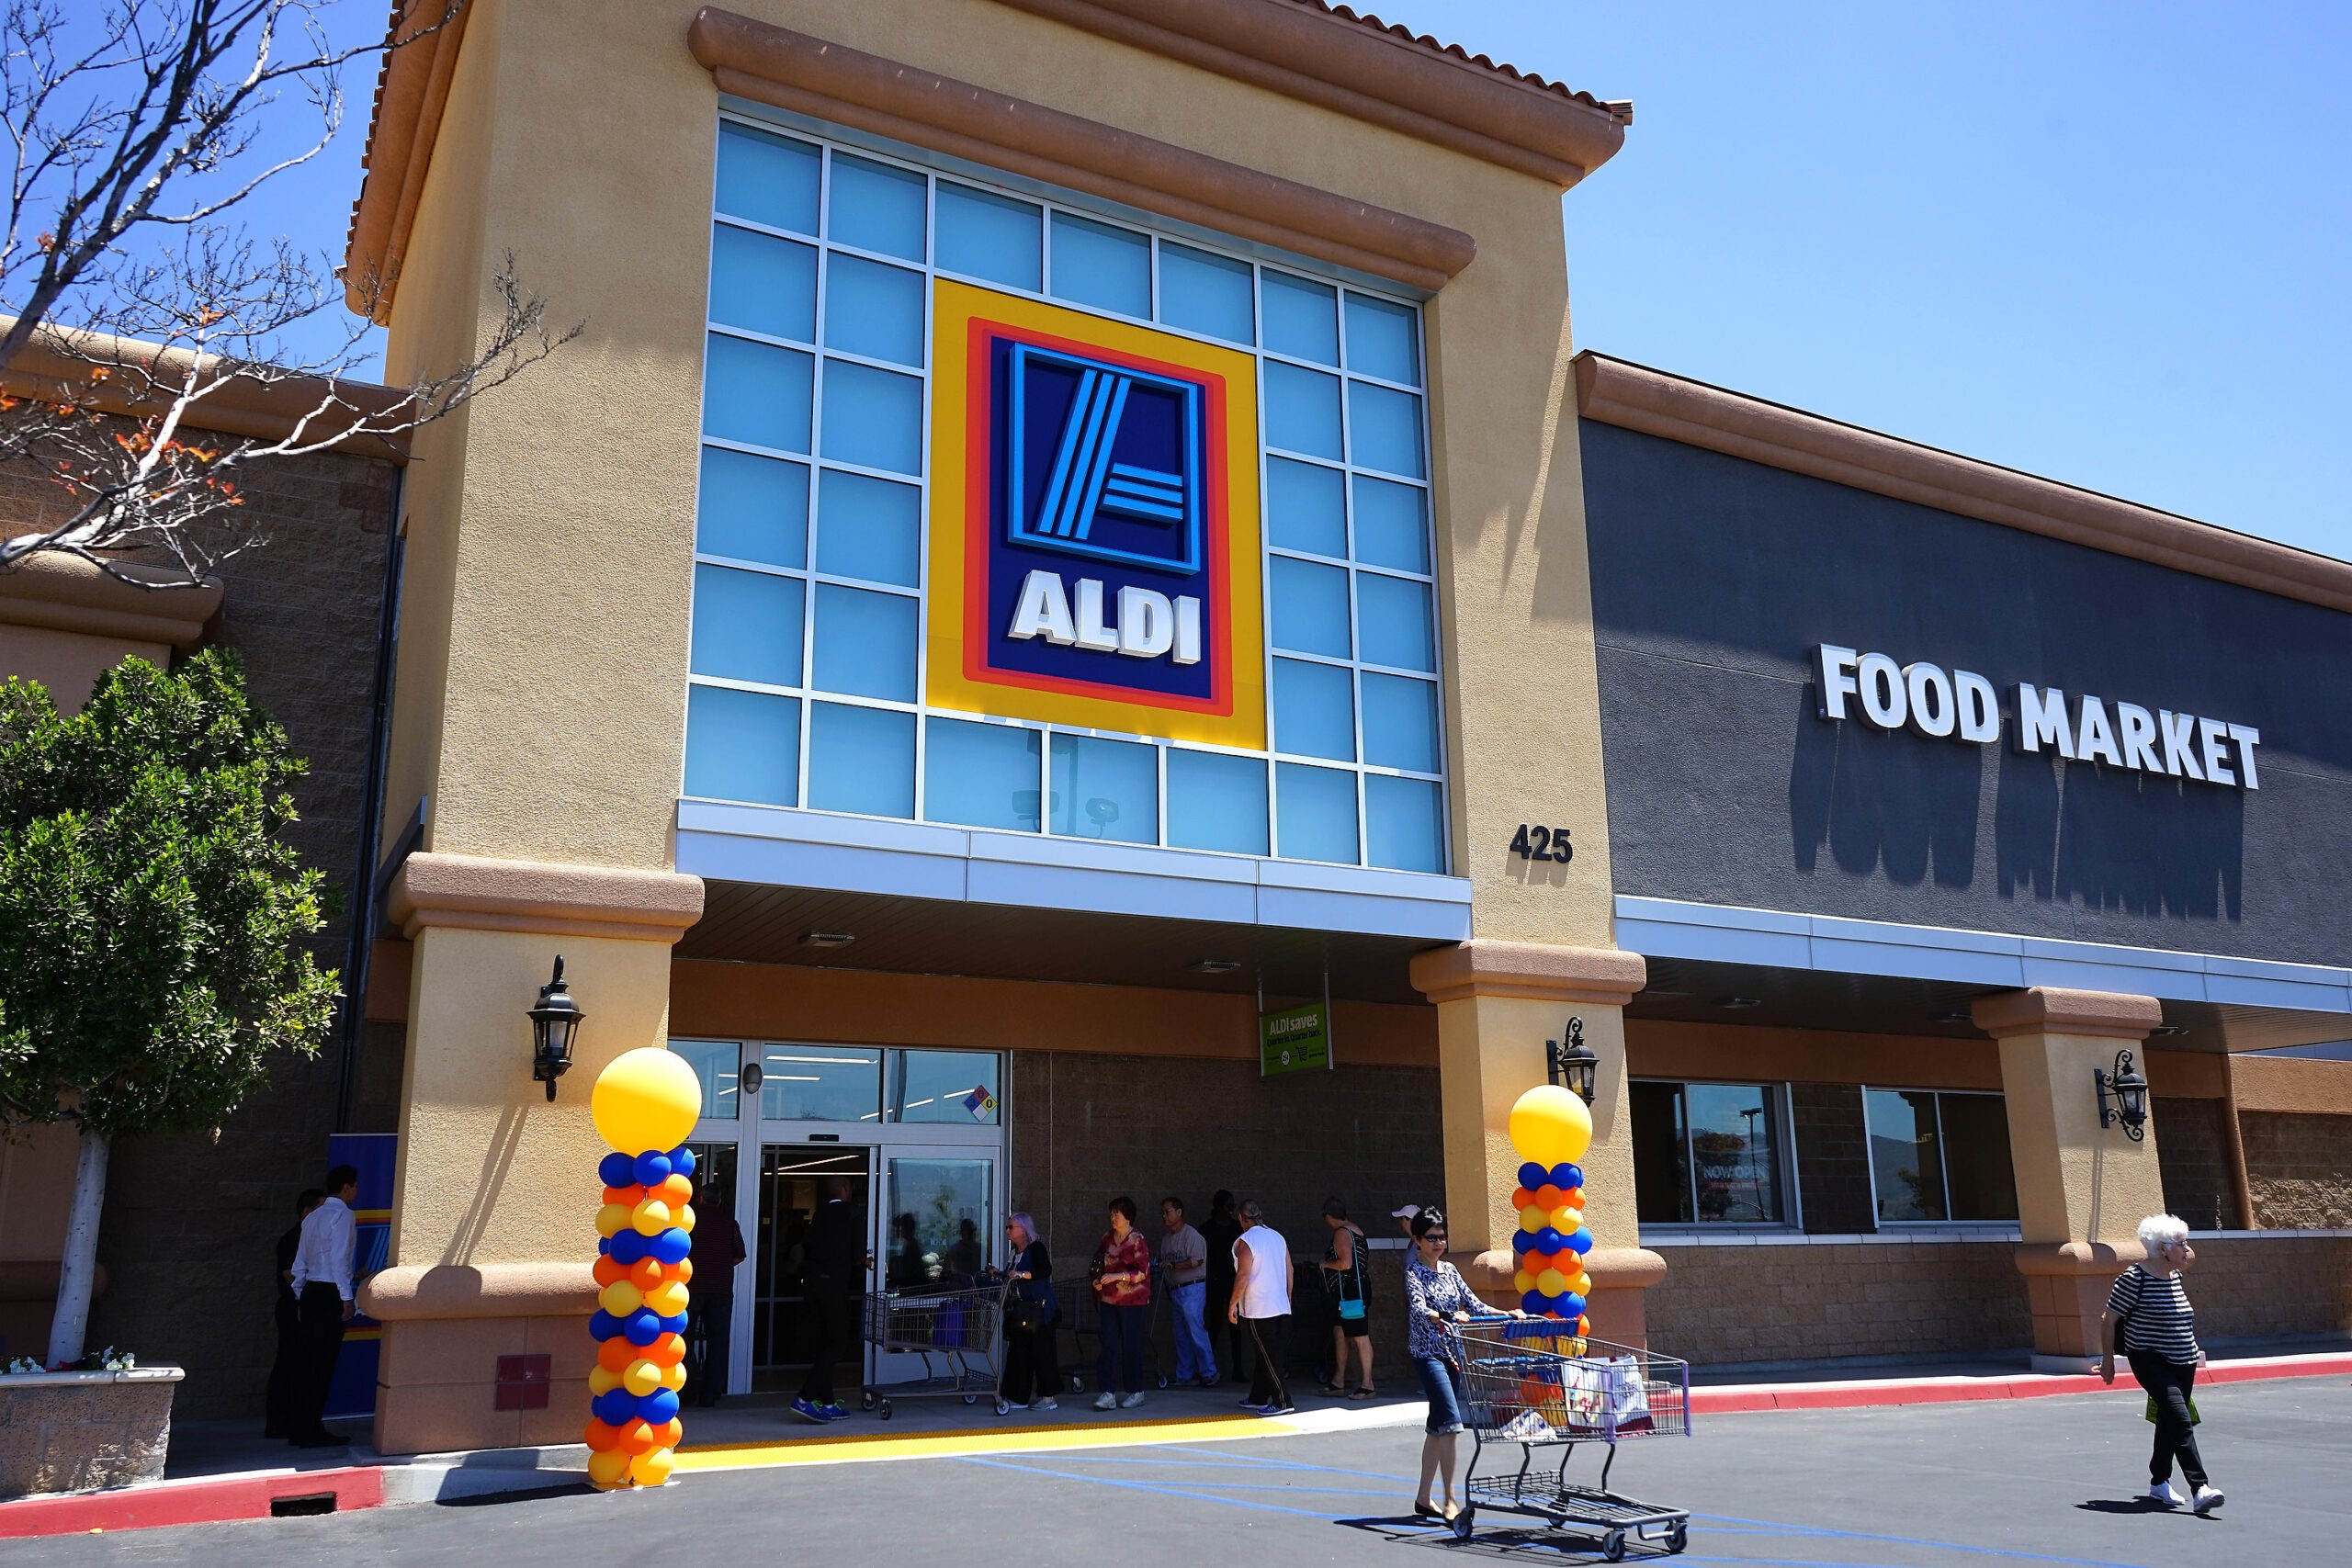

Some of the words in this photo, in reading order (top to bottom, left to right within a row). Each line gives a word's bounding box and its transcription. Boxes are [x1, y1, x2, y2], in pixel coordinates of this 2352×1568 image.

[1009, 570, 1201, 664] ALDI
[1815, 643, 2000, 743] FOOD
[2014, 682, 2260, 790] MARKET
[1510, 823, 1573, 863] 425
[978, 1090, 984, 1099] 0
[986, 1099, 992, 1108] 0
[1702, 1165, 1732, 1179] NOW
